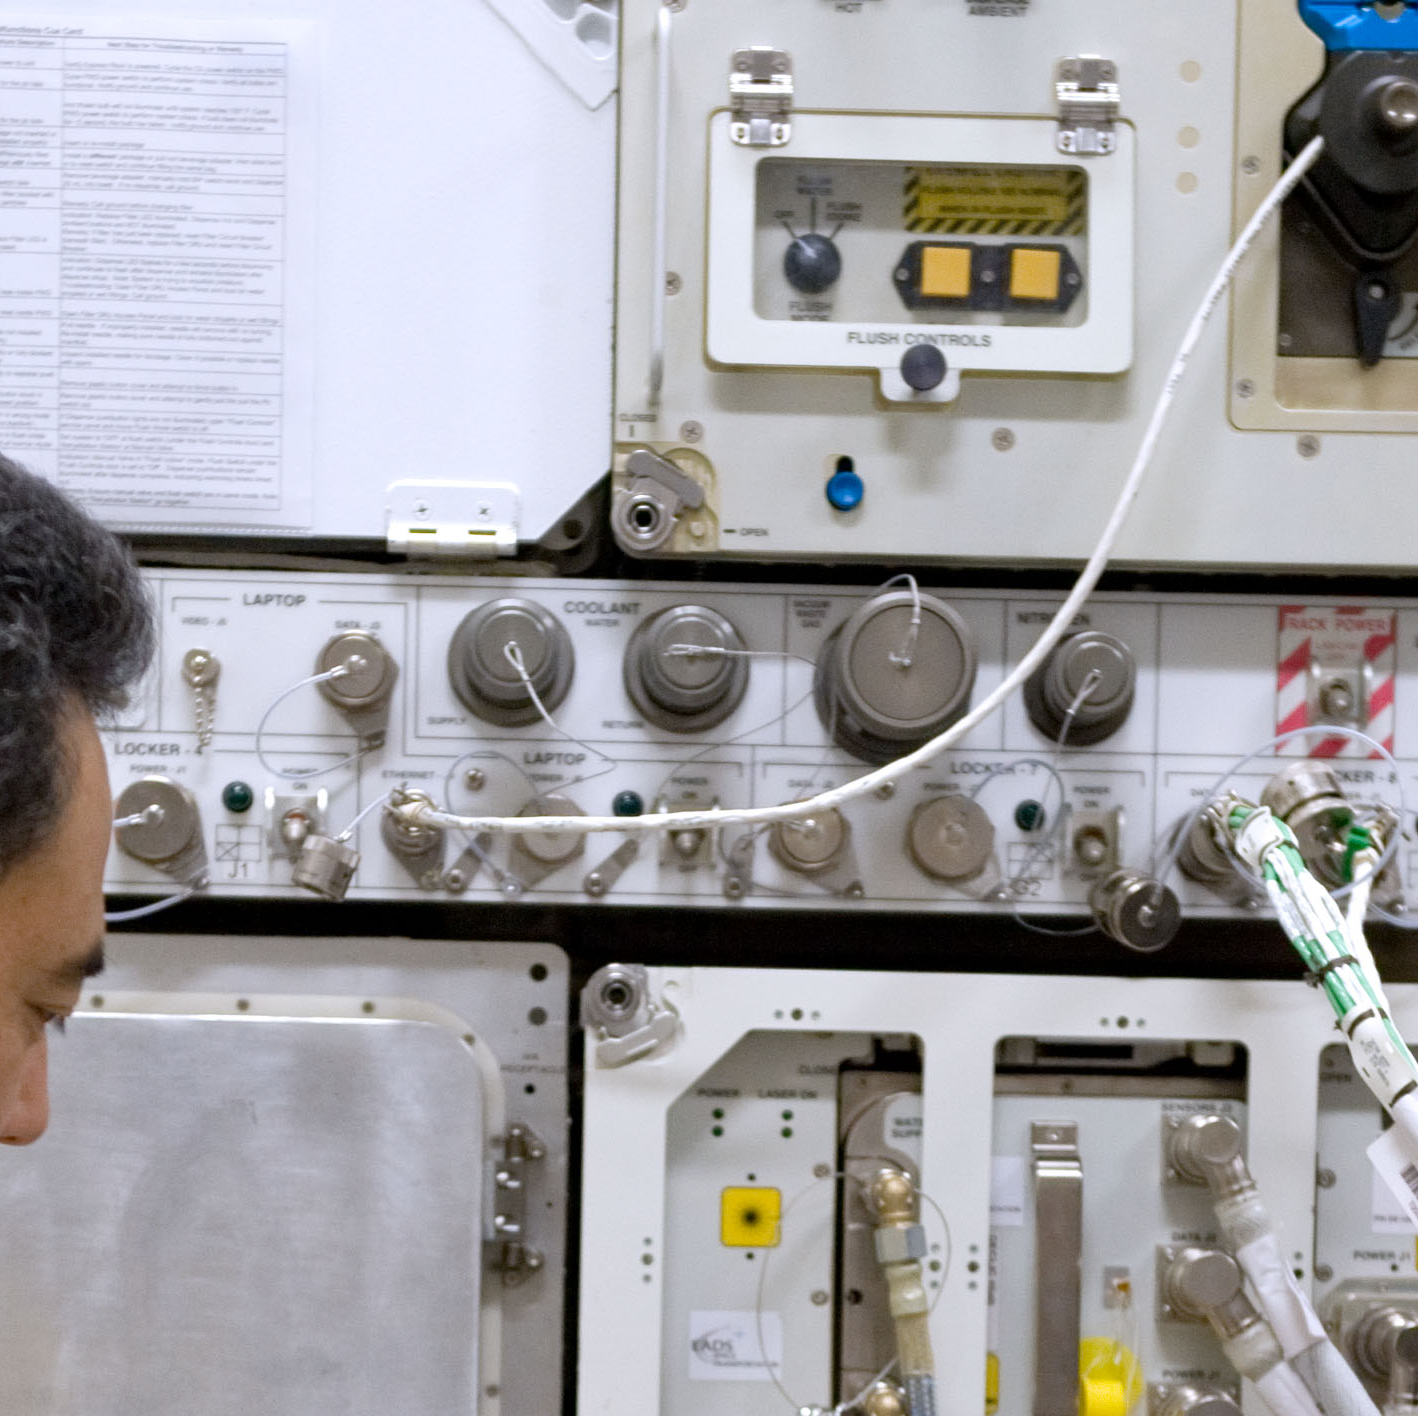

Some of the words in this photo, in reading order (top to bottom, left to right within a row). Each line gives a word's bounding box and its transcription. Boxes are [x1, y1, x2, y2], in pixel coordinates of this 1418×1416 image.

[847, 331, 900, 345] FLUSH
[903, 333, 992, 348] CONTROLS
[739, 527, 769, 537] OPEN
[242, 593, 307, 607] LAPTOP
[564, 600, 641, 615] COOLANT
[1017, 611, 1090, 626] NITREN
[1334, 617, 1387, 632] POWER
[114, 743, 181, 757] LOCKER
[523, 752, 586, 766] LAPTOP
[951, 761, 1015, 776] LOCKER
[1353, 1250, 1396, 1262] POWER
[691, 1338, 734, 1354] EADS
